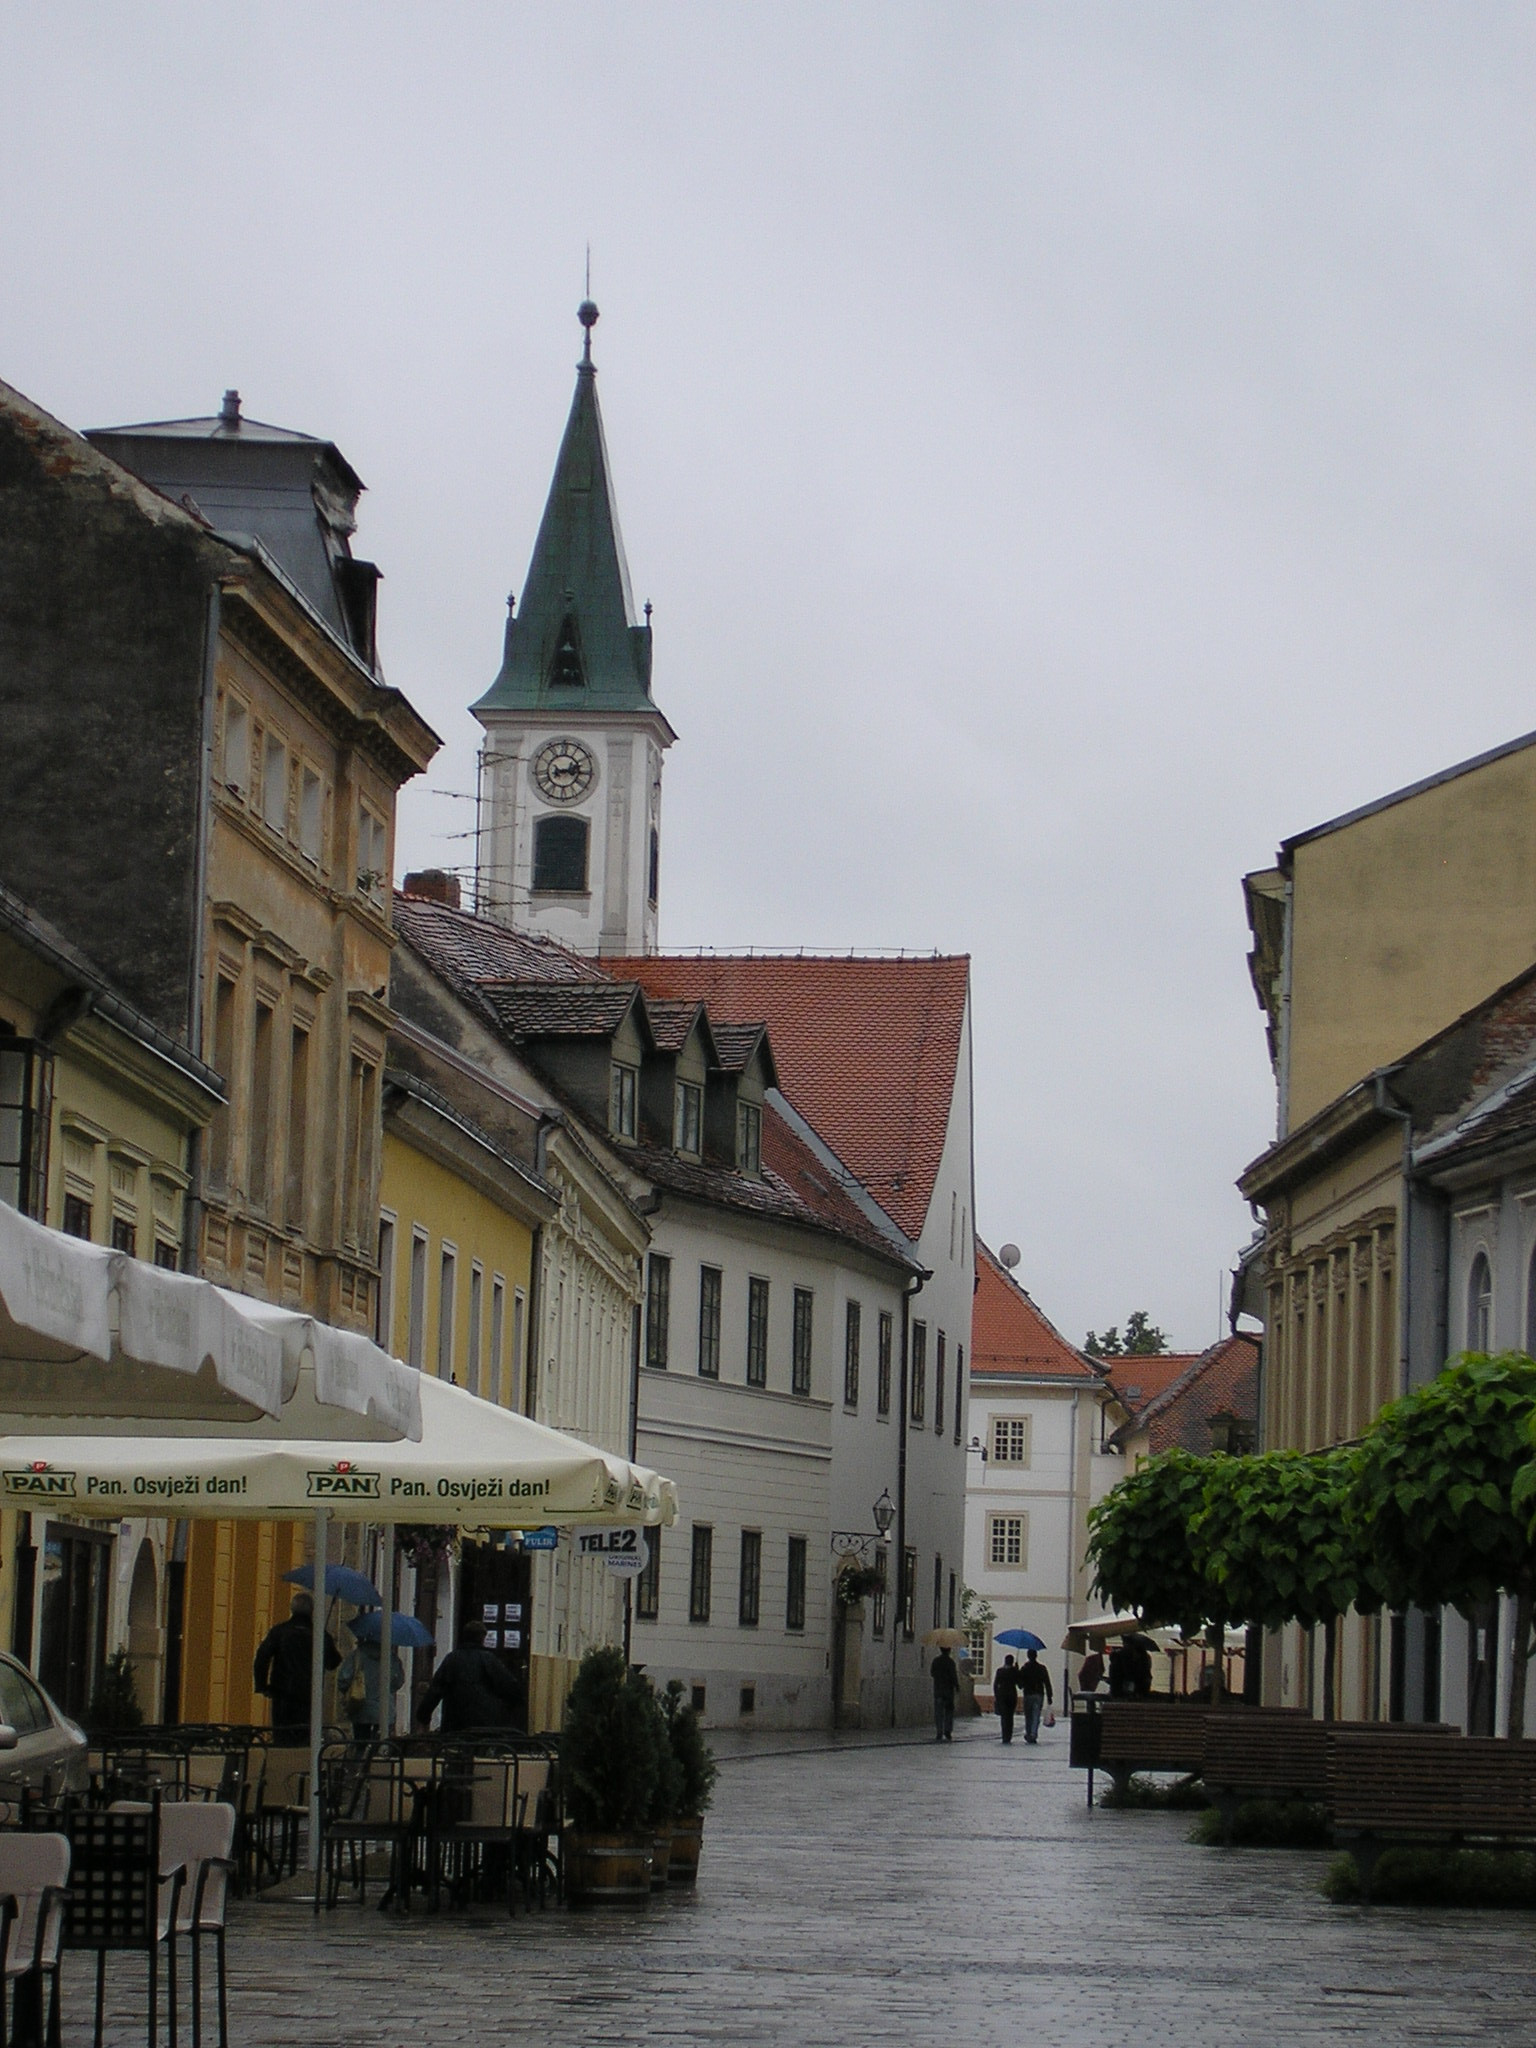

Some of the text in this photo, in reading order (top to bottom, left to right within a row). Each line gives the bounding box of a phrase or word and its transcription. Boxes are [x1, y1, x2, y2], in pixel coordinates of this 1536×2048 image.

[12, 1476, 67, 1492] PAN
[87, 1475, 247, 1498] Pan. Osvježi dan!
[316, 1477, 371, 1493] PAN
[391, 1478, 550, 1501] Pan. Osvježi dan!
[579, 1529, 637, 1552] TELE2
